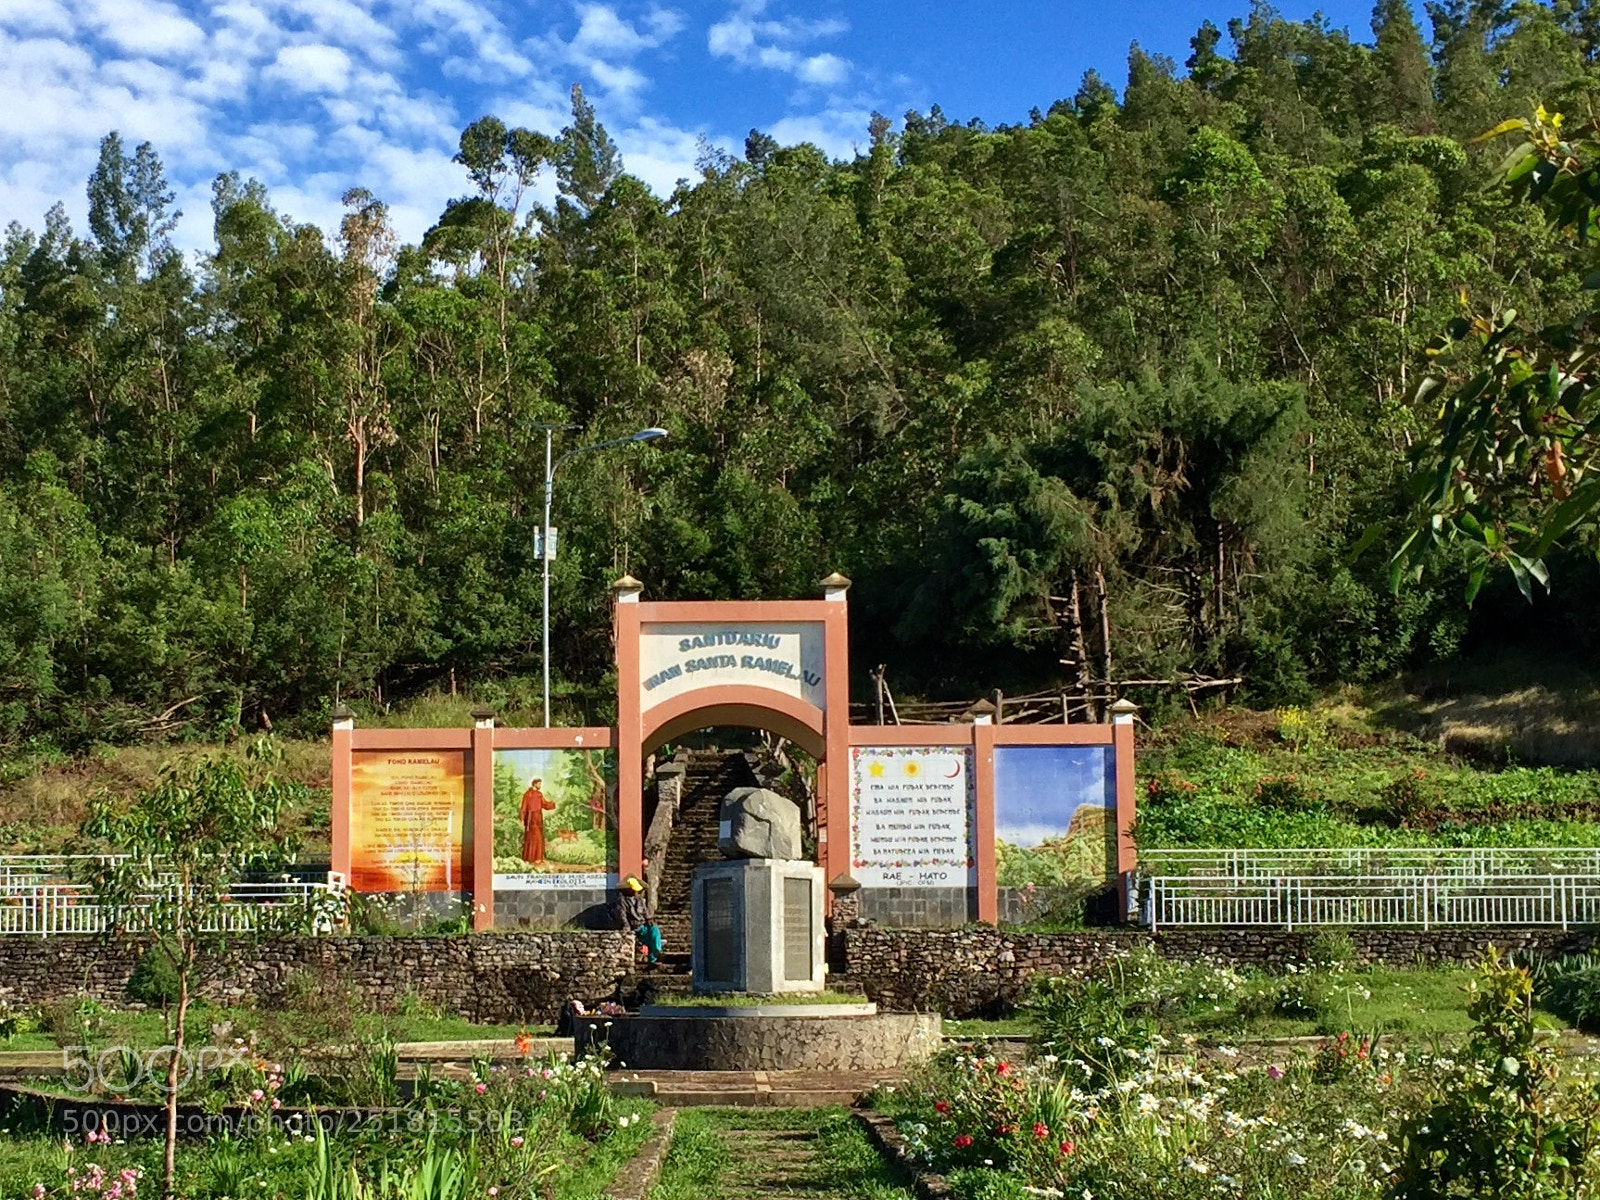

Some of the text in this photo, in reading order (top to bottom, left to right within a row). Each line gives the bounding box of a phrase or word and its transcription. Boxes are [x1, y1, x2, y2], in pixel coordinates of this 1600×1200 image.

[678, 631, 781, 652] SANTUARIU
[684, 654, 737, 673] SANTA
[740, 655, 821, 687] RAMELAU
[882, 872, 902, 880] RAE
[919, 872, 948, 880] HATO
